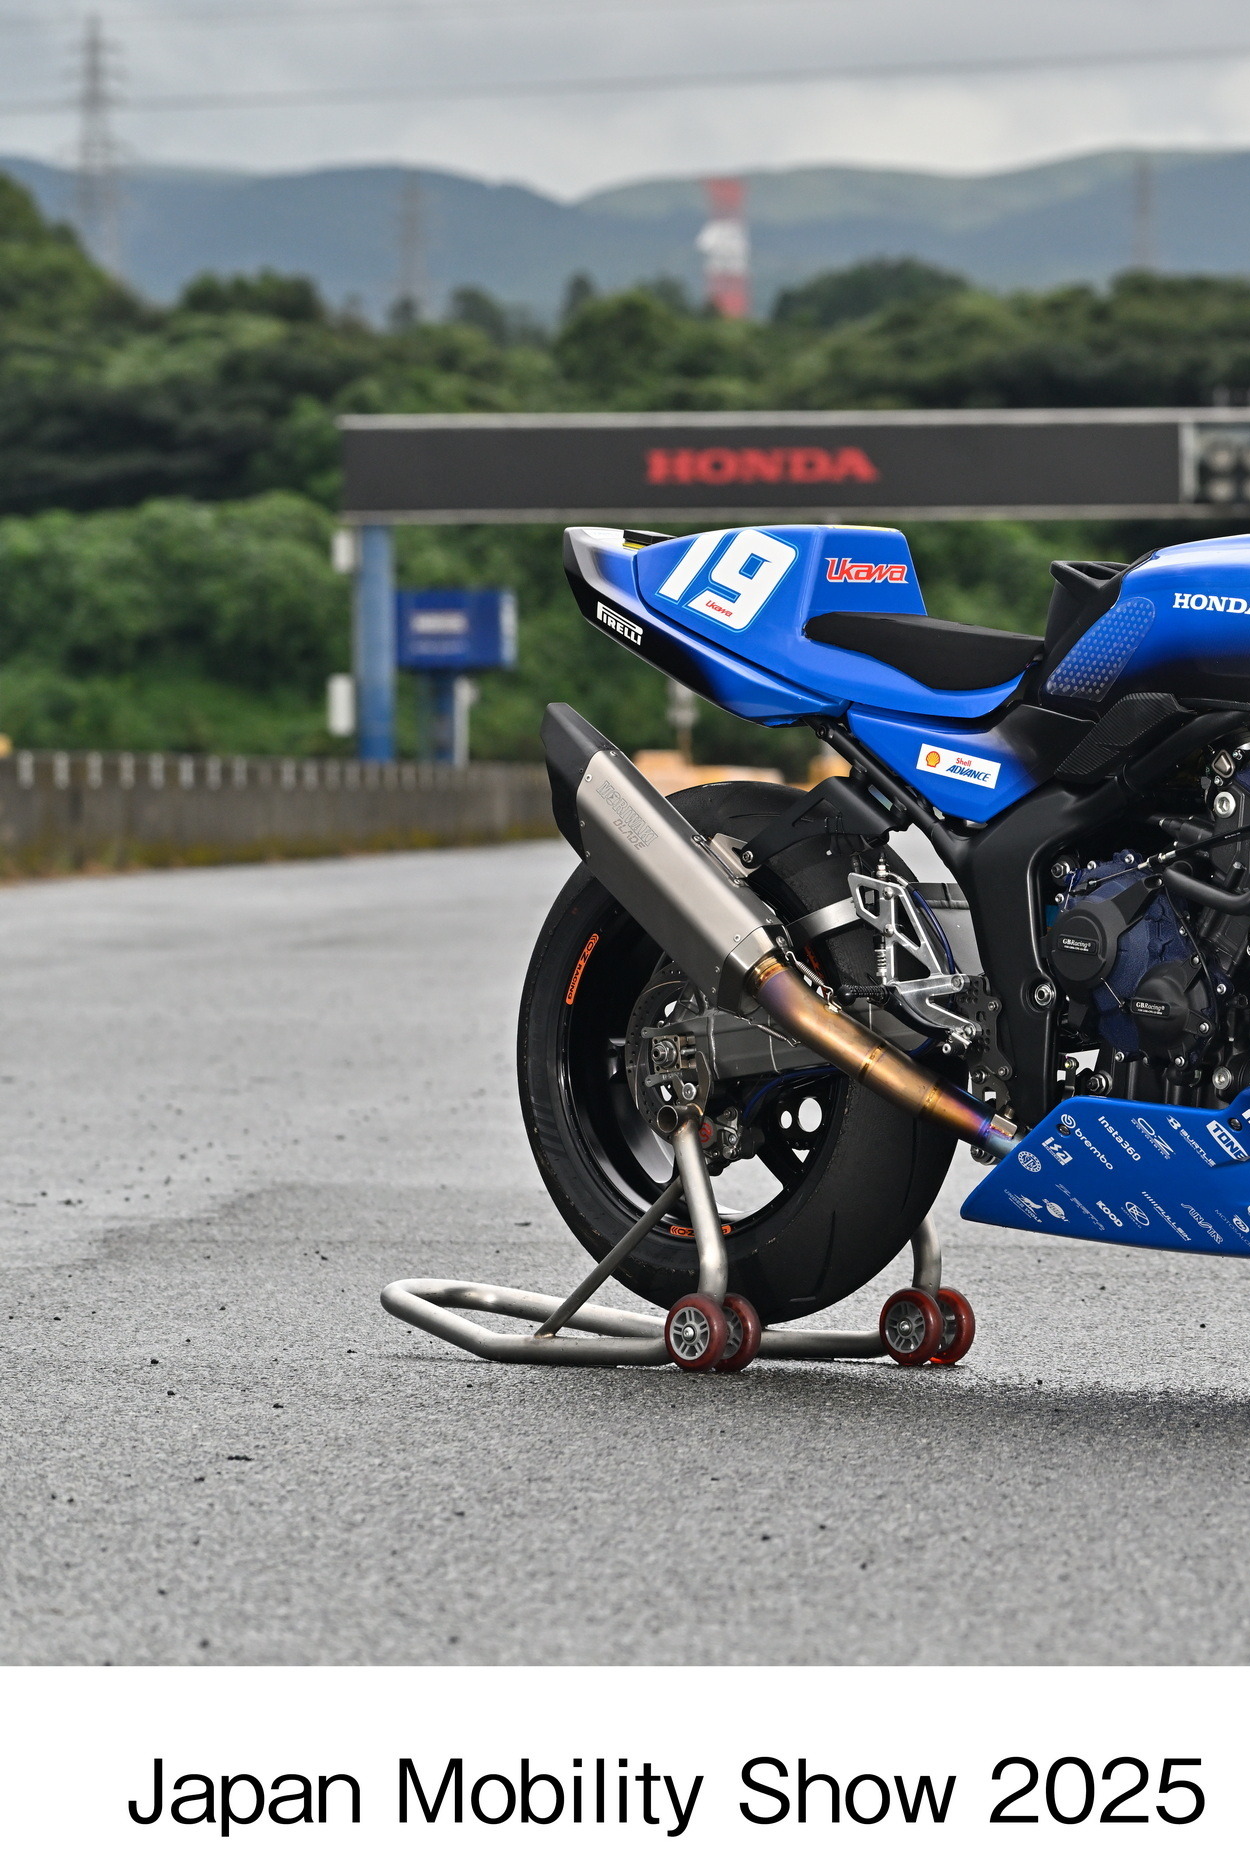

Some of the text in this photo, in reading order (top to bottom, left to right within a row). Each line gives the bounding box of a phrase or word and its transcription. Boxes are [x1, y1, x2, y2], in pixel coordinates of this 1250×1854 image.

[646, 446, 880, 485] HONDA
[655, 528, 799, 632] 19
[825, 557, 909, 584] Ukawa
[596, 600, 644, 646] PIRELLI
[946, 764, 991, 783] ADVANCE
[955, 757, 972, 767] Shell
[613, 818, 646, 850] BLADE
[567, 963, 583, 1000] RACING
[1074, 1128, 1114, 1170] brembo
[1097, 1115, 1142, 1162] Insta360
[1211, 1122, 1247, 1159] TONE
[1096, 1200, 1124, 1228] KOOD
